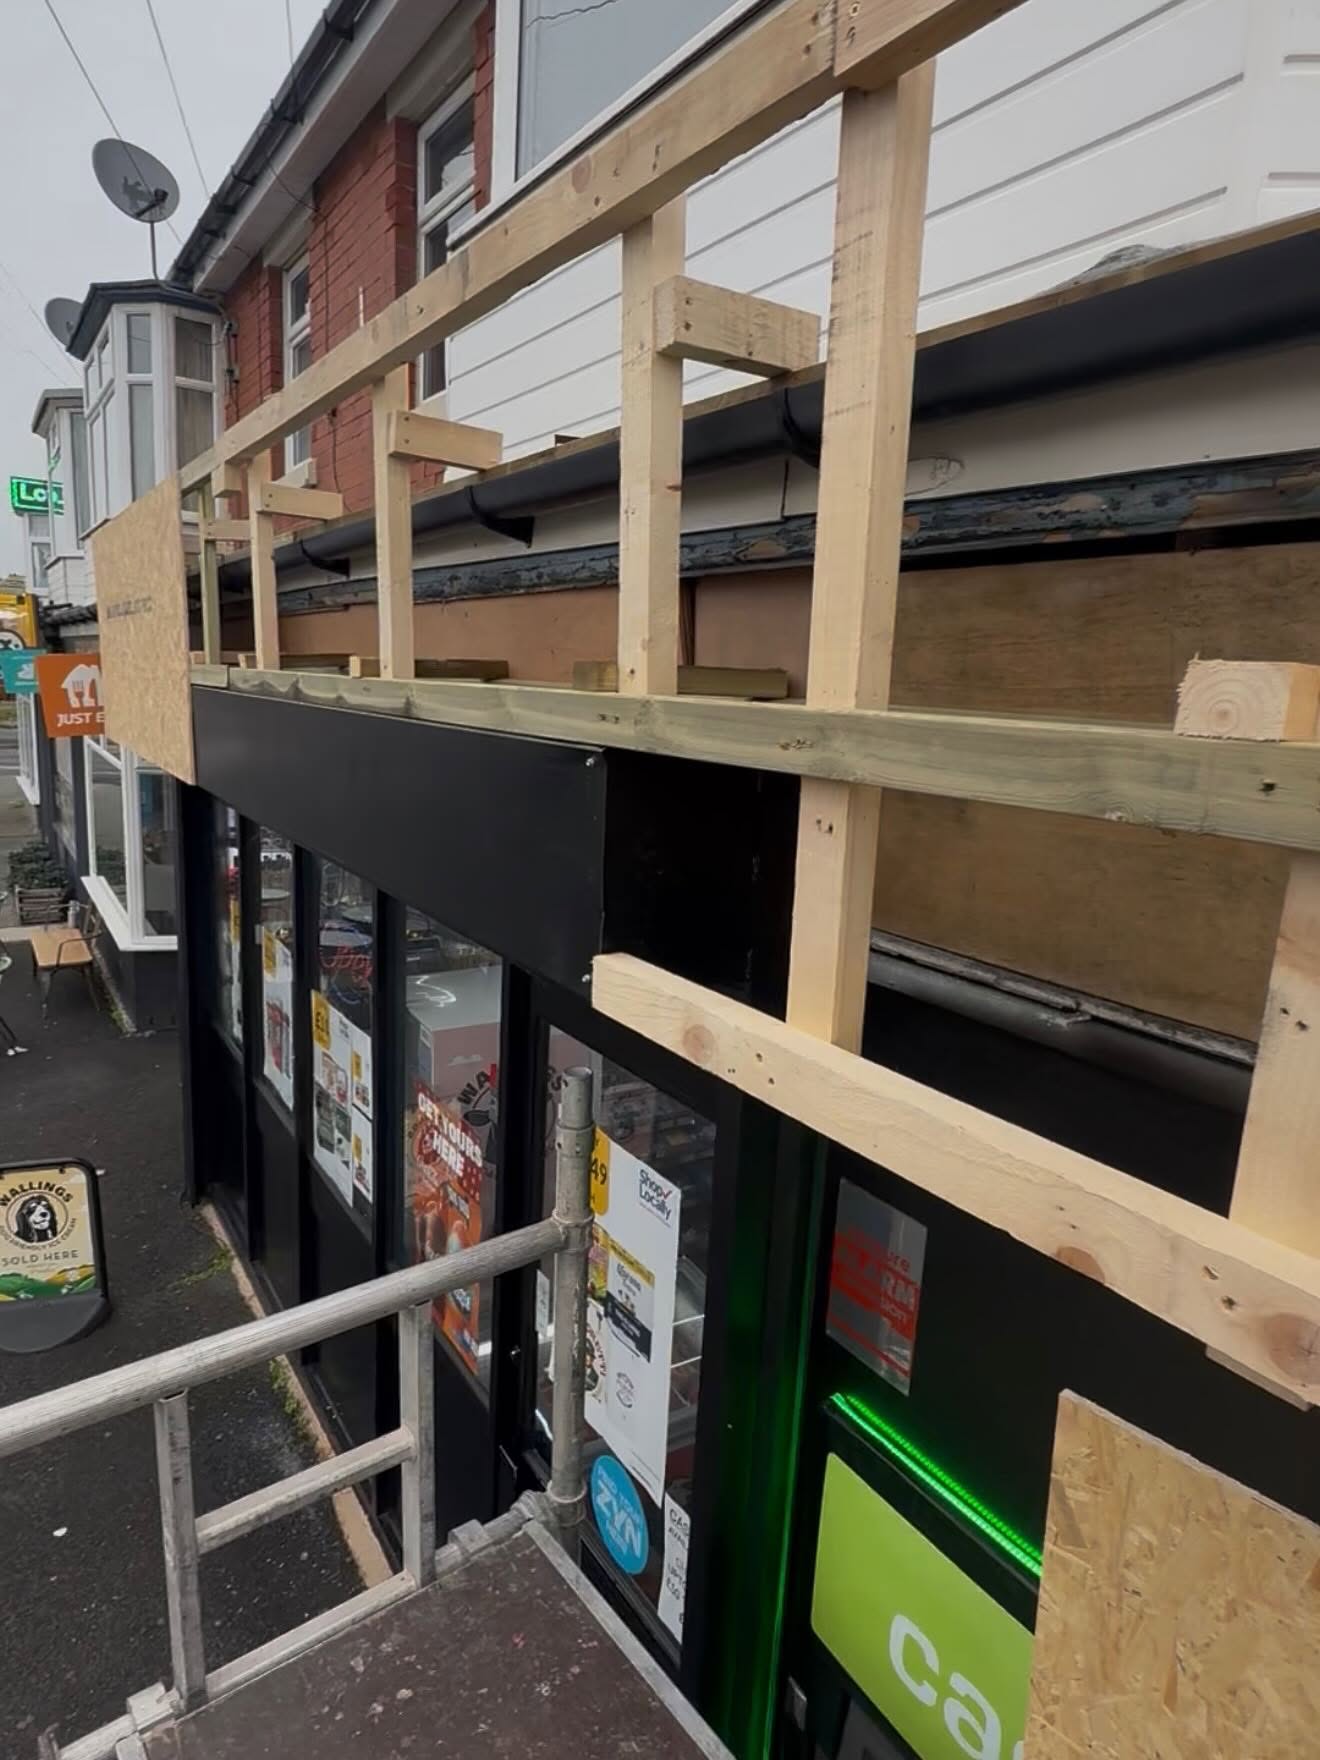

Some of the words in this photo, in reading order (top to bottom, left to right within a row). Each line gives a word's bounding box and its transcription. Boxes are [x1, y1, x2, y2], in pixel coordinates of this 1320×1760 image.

[57, 711, 93, 727] JUST
[418, 1092, 440, 1127] GET
[440, 1112, 483, 1168] YOURS
[432, 1130, 464, 1178] HERE
[0, 1181, 74, 1206] WALLINGS
[639, 1168, 663, 1198] Shop
[639, 1183, 672, 1221] Locally
[1, 1254, 39, 1267] SOLD
[43, 1249, 80, 1261] HERE
[596, 1479, 642, 1559] ZYN
[670, 1508, 689, 1538] CAS
